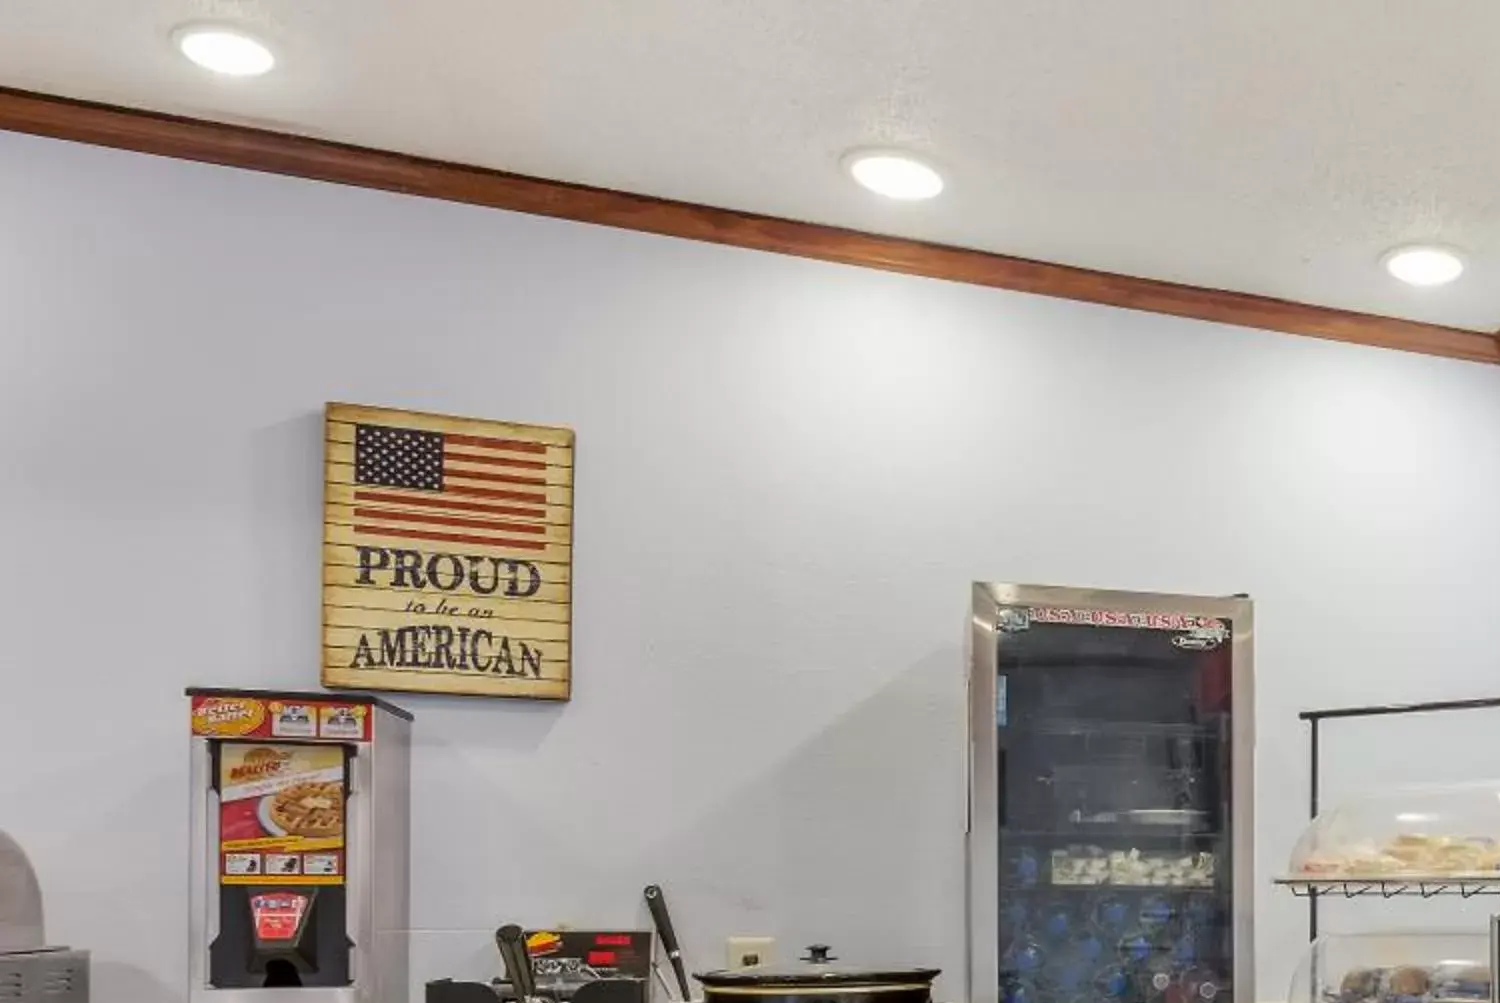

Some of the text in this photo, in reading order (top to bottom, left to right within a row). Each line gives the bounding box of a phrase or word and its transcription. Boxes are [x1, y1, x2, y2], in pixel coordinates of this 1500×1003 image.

[354, 545, 541, 597] PROUD
[404, 598, 494, 619] to be an
[349, 624, 544, 680] AMERICAN
